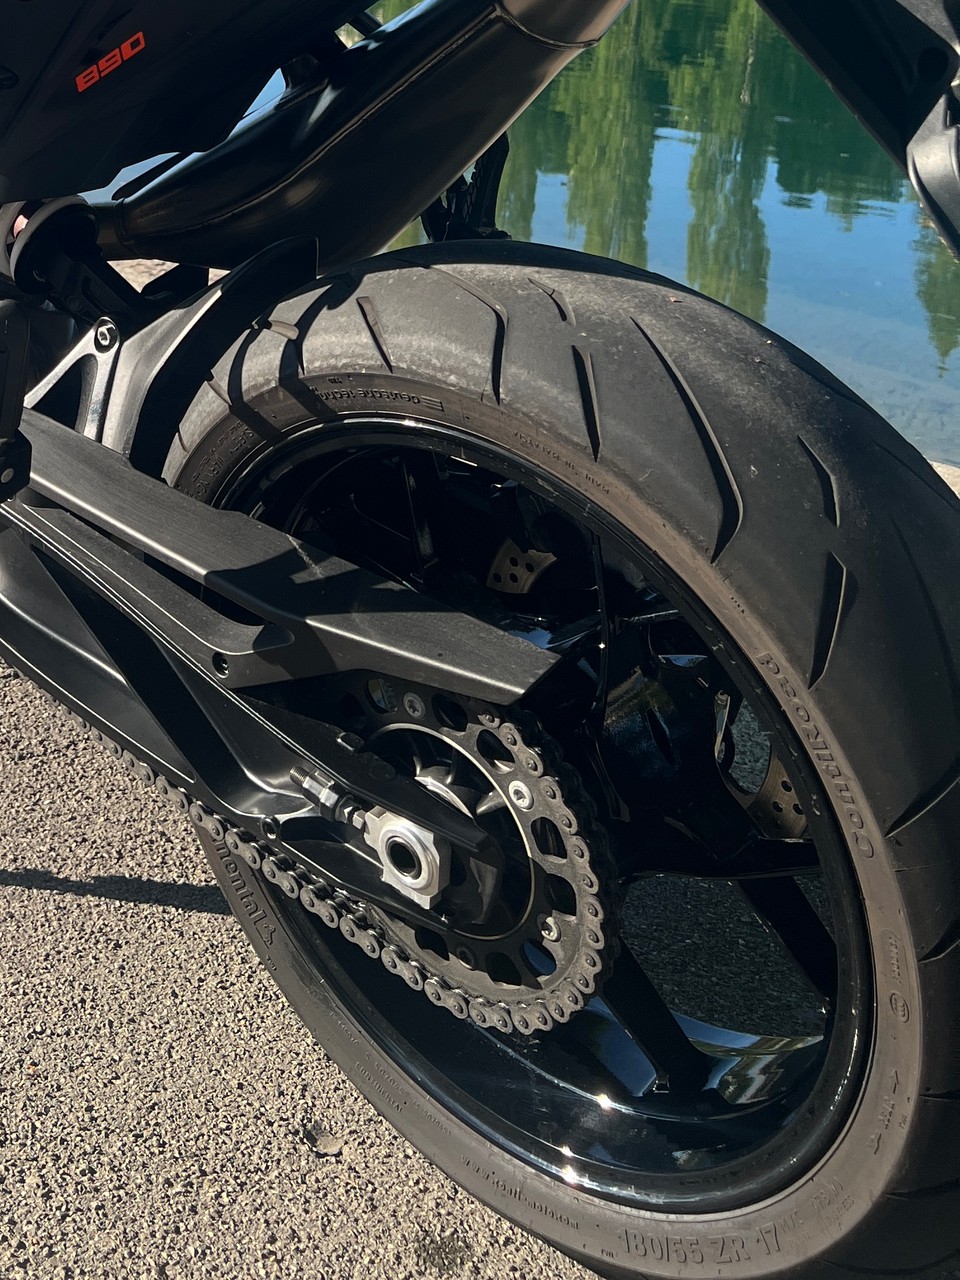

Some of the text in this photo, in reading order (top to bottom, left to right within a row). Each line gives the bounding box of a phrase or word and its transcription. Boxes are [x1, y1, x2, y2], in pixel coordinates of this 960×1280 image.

[75, 30, 146, 93] 890
[359, 388, 420, 404] deutsche
[755, 651, 875, 859] ContiRoad
[212, 838, 268, 927] nental
[617, 1228, 705, 1266] 180/55
[710, 1232, 751, 1265] ZR
[756, 1221, 782, 1256] 17
